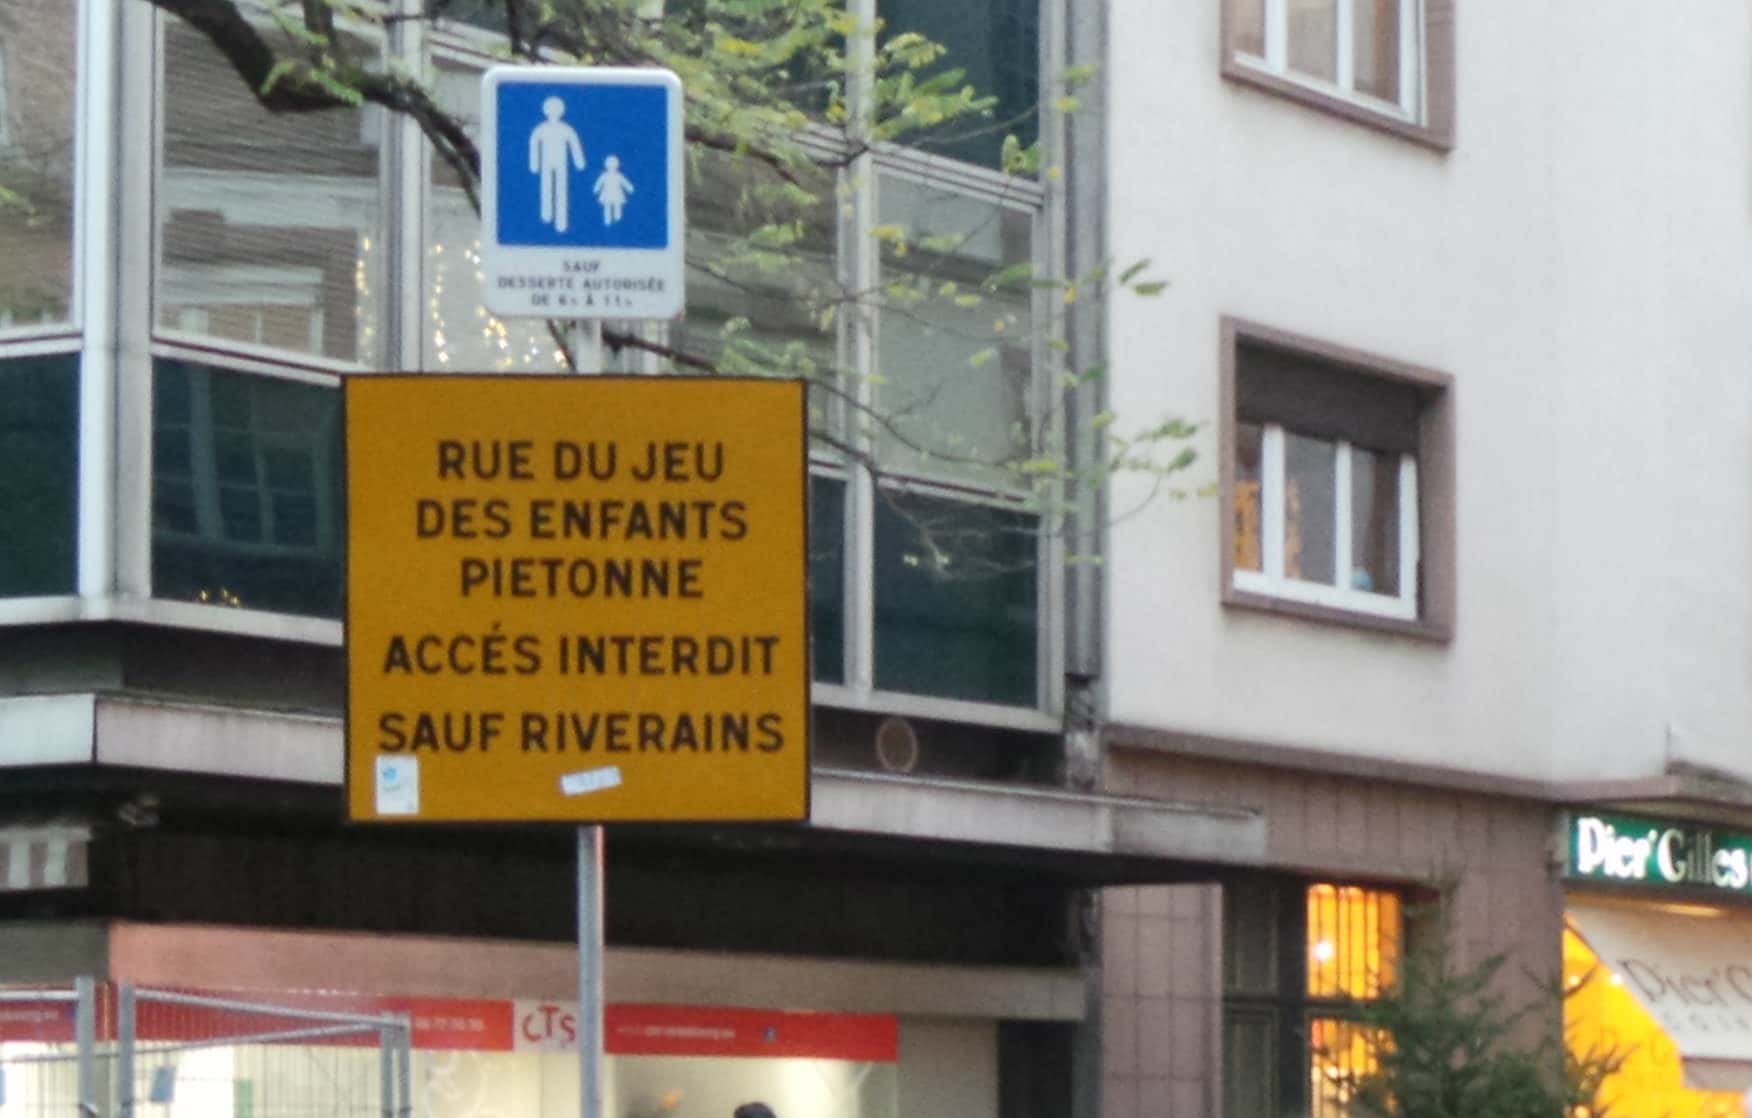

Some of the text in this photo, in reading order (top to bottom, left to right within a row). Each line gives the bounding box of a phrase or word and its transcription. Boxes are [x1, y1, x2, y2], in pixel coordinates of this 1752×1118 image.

[497, 276, 574, 290] DESSERTE
[562, 260, 600, 273] SAUF
[531, 294, 549, 306] DE
[437, 439, 725, 482] RUE DU JEU
[416, 499, 748, 541] DES ENFANTS
[460, 558, 705, 599] PIETONNE
[383, 624, 780, 676] ACCÉS INTERDIT
[377, 712, 785, 754] SAUF RIVERAINS
